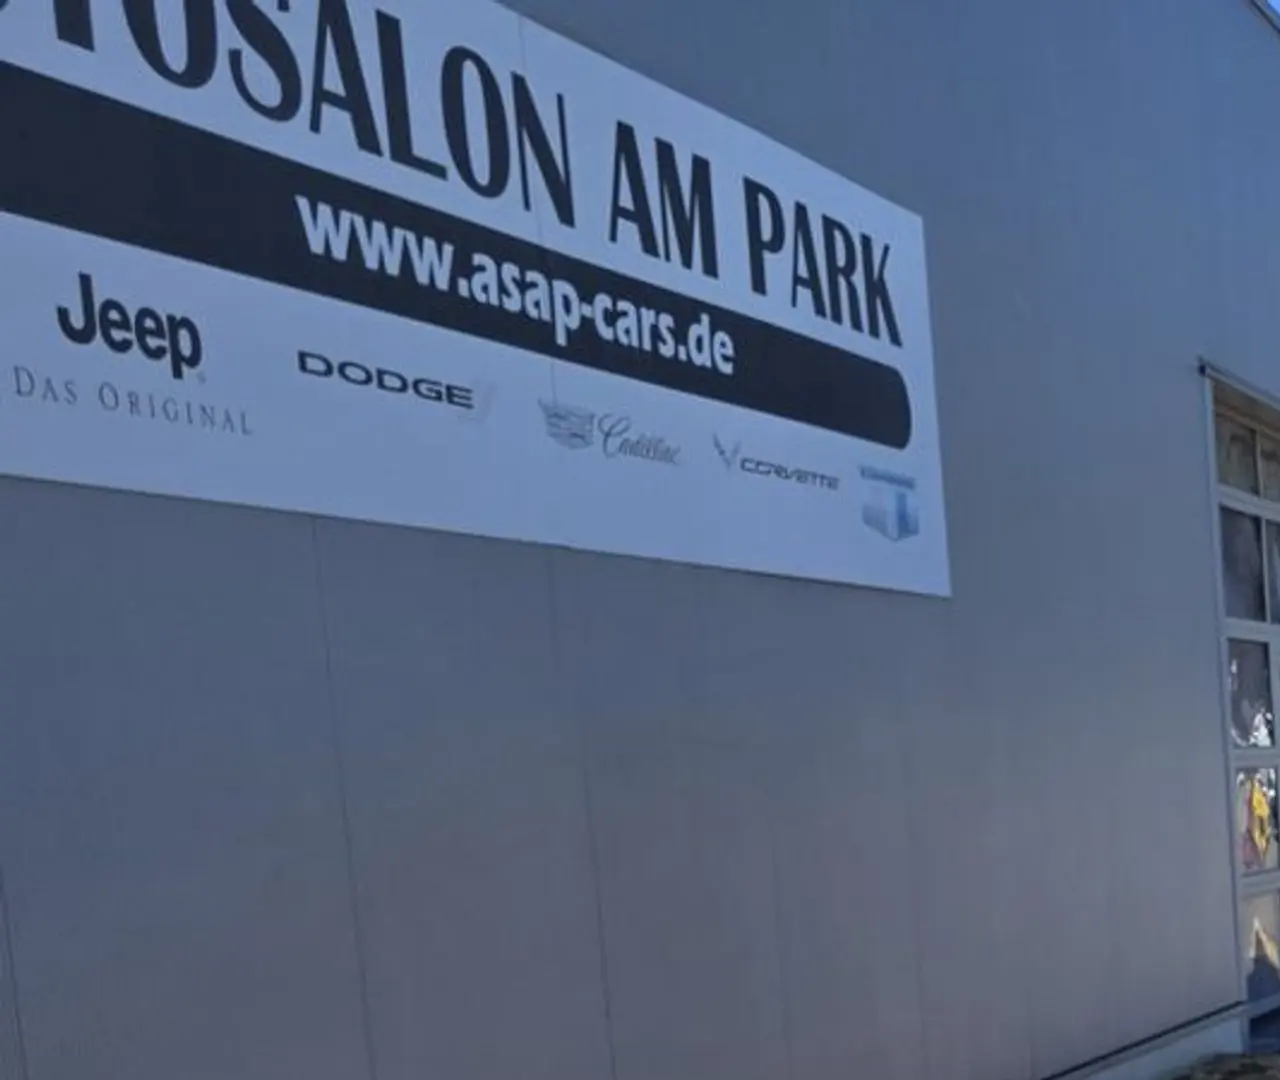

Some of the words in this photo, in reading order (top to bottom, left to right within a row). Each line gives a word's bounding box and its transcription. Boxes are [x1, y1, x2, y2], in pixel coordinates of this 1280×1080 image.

[295, 194, 735, 376] www.asap-cars.de
[609, 119, 719, 280] AM
[743, 176, 903, 349] PARK
[57, 271, 203, 379] Jeep
[297, 350, 475, 410] DODGE
